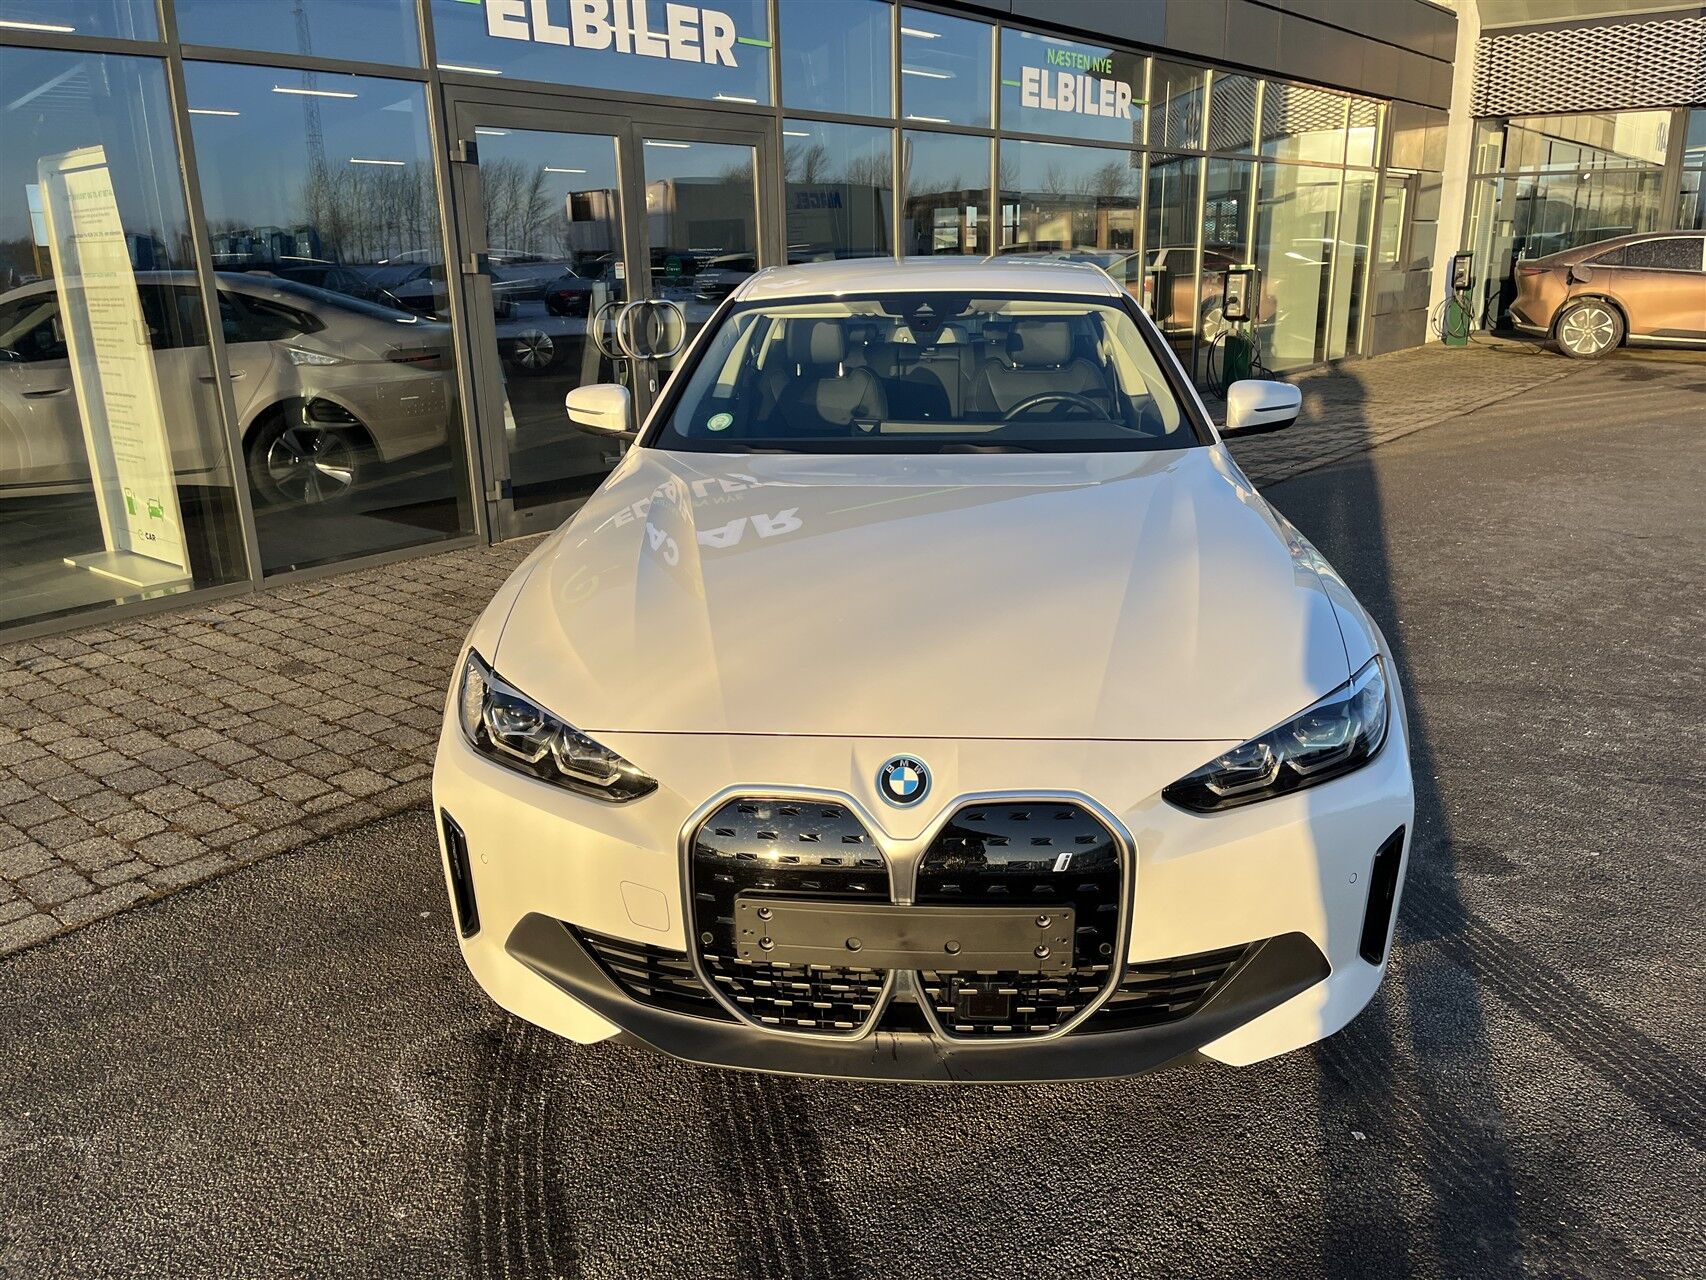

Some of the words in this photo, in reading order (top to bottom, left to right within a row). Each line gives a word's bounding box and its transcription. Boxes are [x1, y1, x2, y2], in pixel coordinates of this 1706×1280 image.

[484, 0, 739, 68] ELBILER
[1046, 47, 1091, 71] NÆSTEN
[1092, 56, 1113, 75] NYE
[1021, 65, 1132, 120] ELBILER
[145, 532, 156, 541] CAR
[885, 759, 925, 775] BMW
